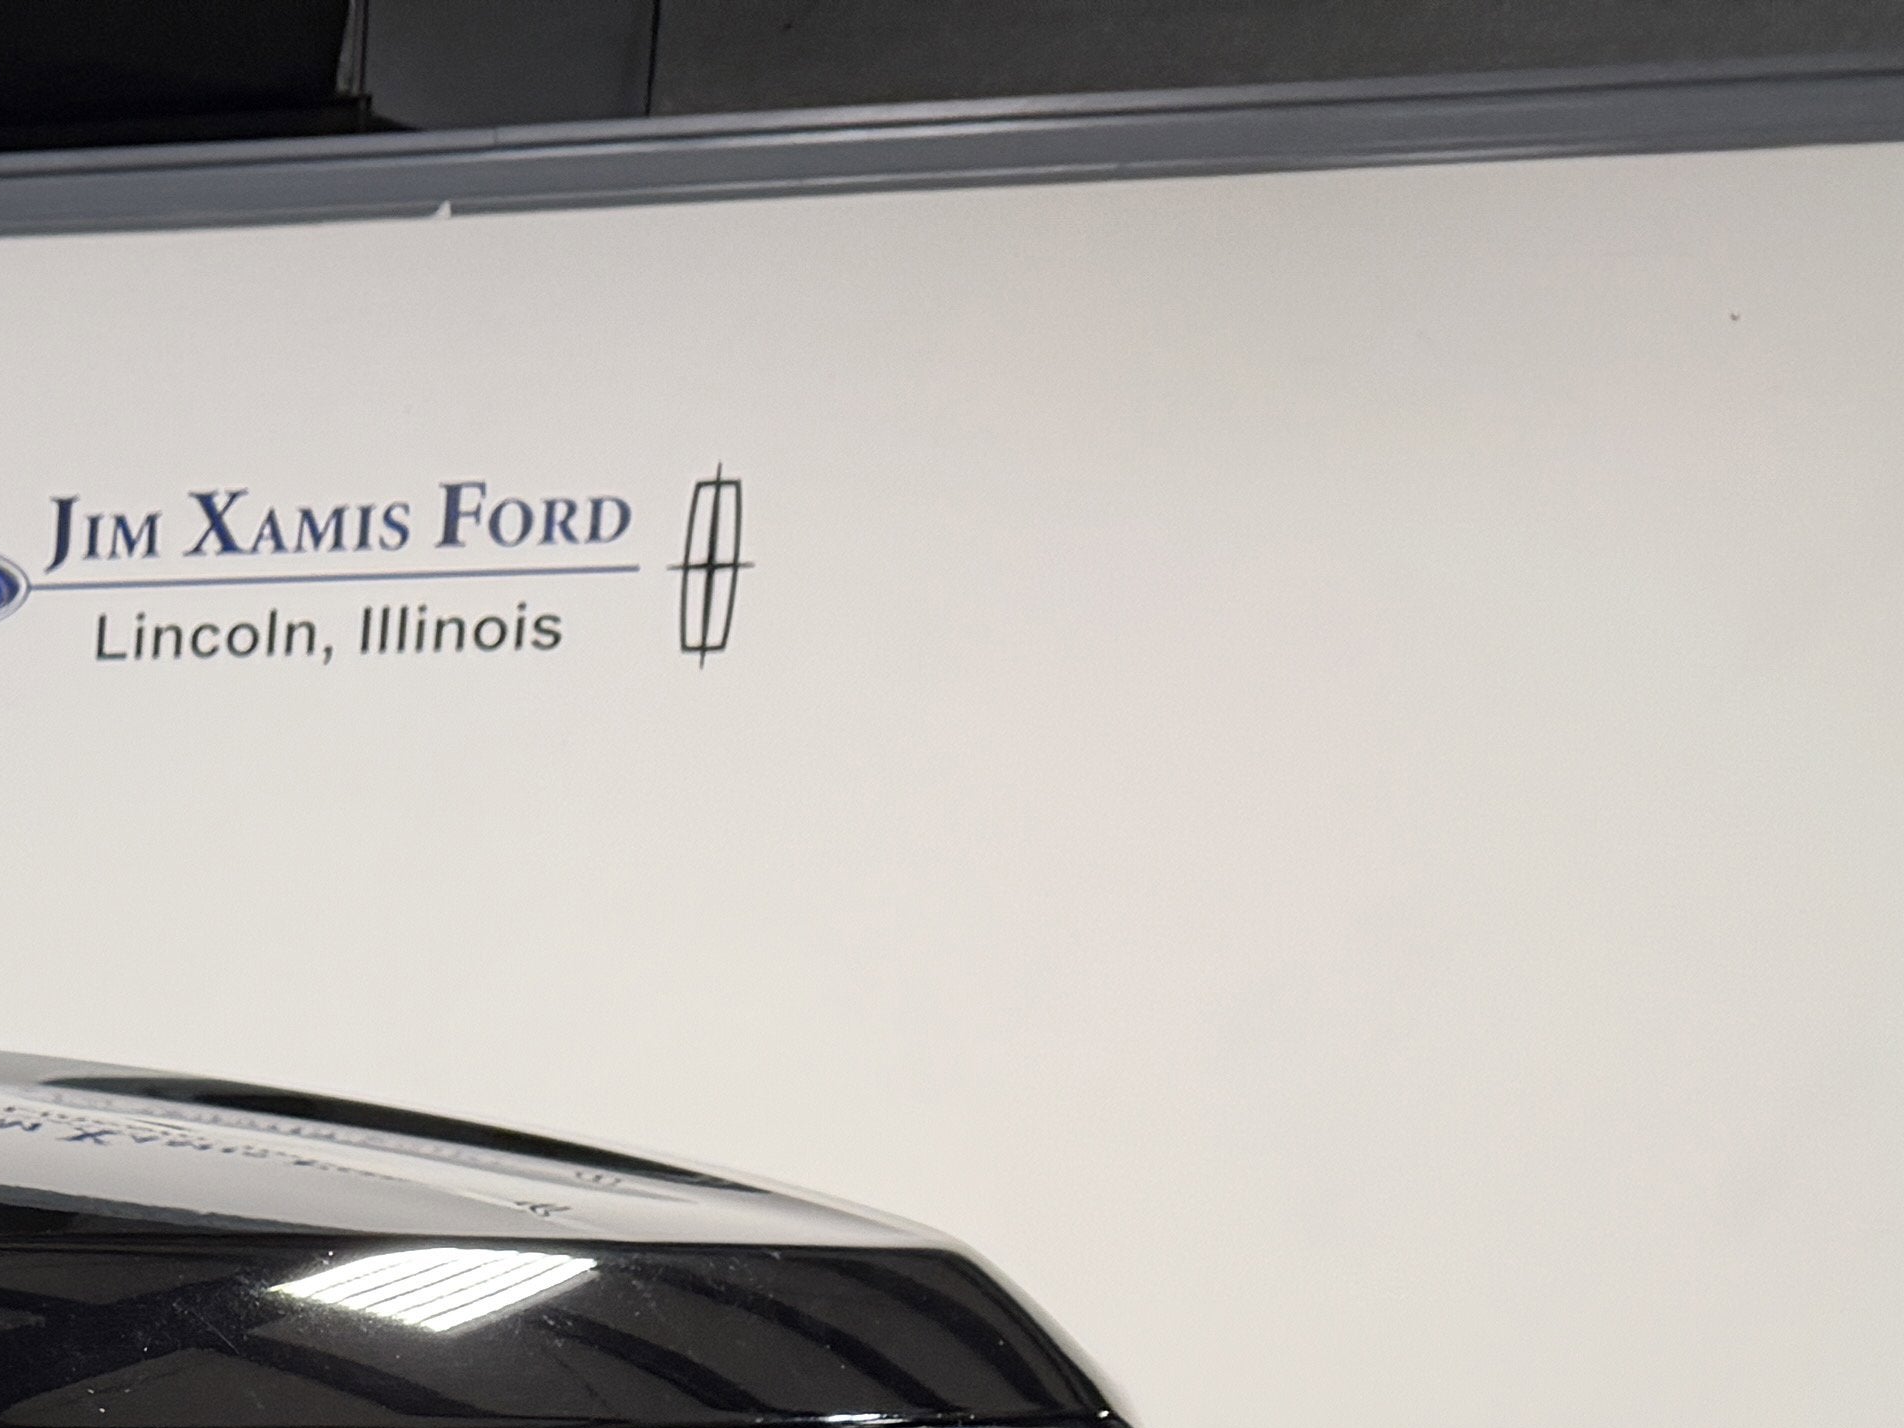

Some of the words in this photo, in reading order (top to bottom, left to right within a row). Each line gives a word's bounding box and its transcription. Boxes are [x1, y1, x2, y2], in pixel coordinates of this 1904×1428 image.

[44, 494, 162, 574] JIM
[183, 487, 410, 558] XAMIS
[435, 481, 632, 548] FORD
[96, 608, 333, 665] Lincoln,
[361, 602, 563, 654] Illinois
